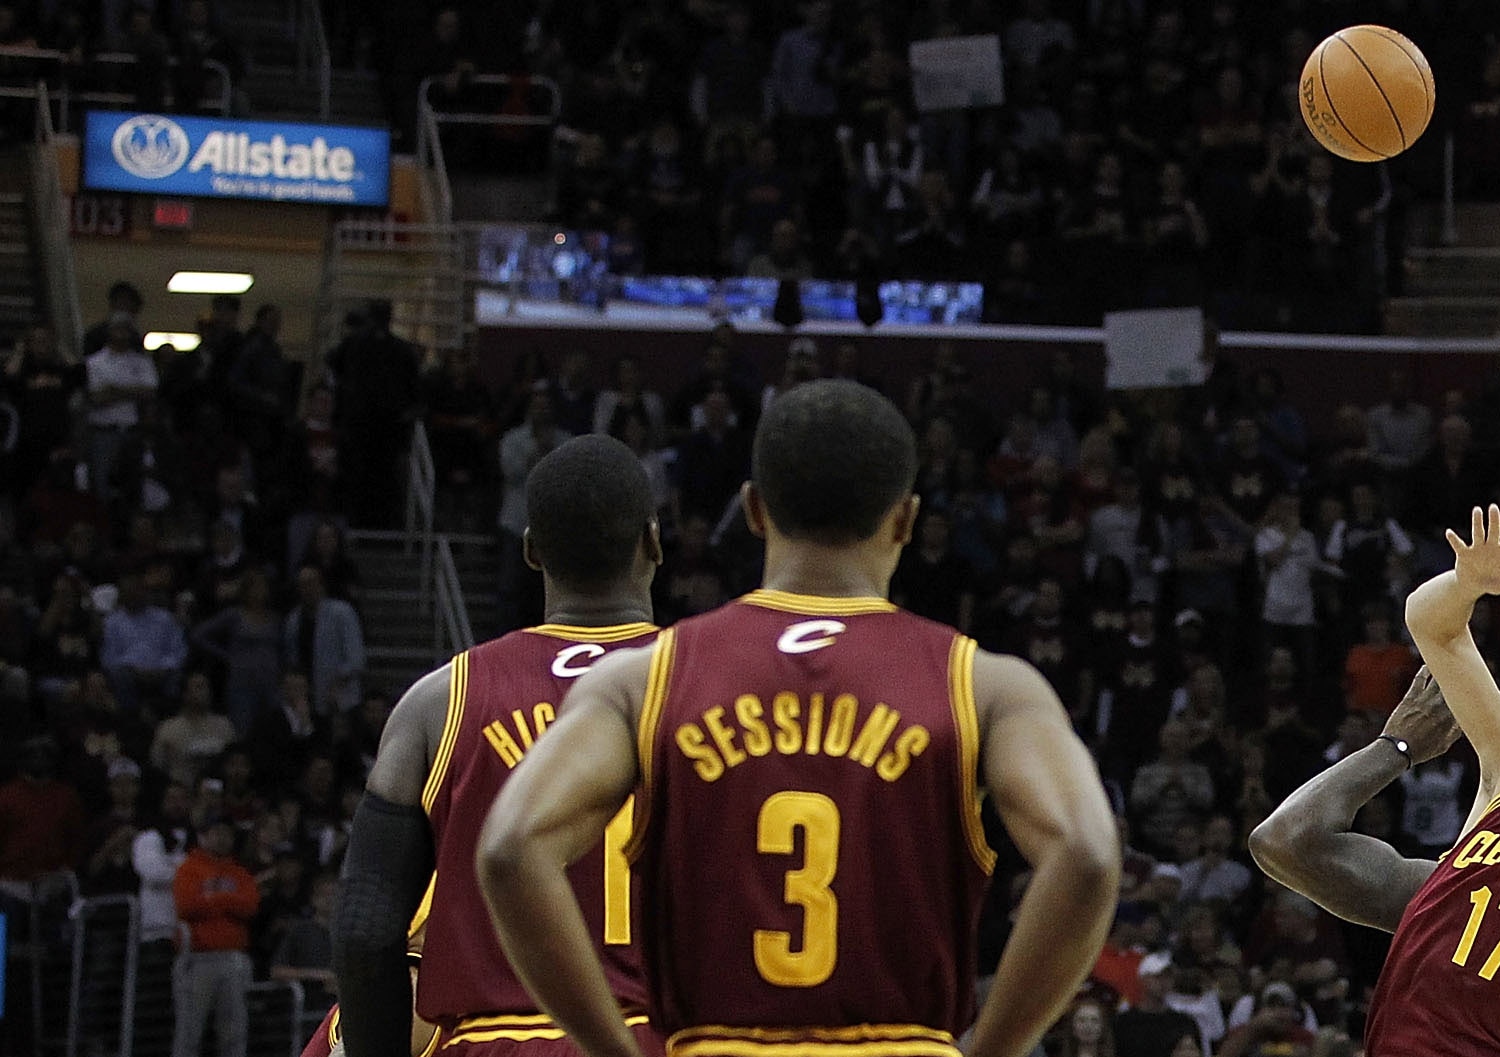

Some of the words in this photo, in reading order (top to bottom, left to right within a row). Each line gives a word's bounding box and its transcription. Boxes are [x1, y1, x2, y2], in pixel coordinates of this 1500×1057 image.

[1303, 76, 1347, 151] SPALD
[188, 131, 355, 181] Allstate
[675, 691, 931, 783] SESSIONS
[753, 790, 841, 988] 3
